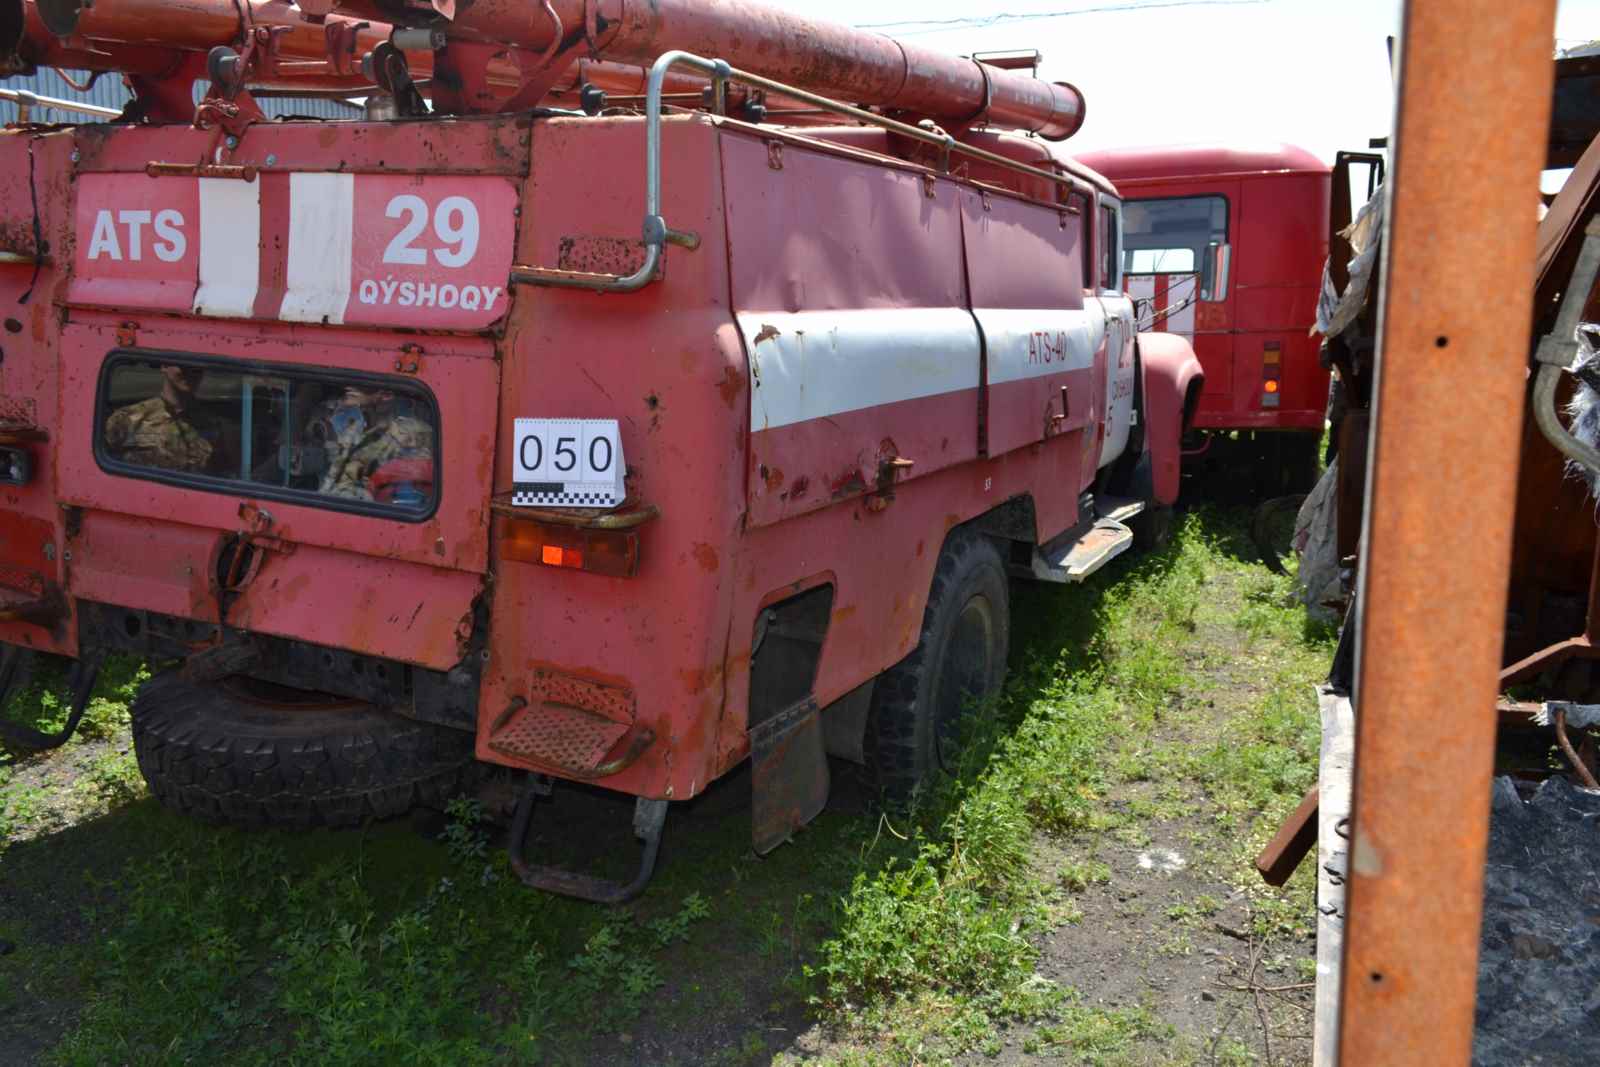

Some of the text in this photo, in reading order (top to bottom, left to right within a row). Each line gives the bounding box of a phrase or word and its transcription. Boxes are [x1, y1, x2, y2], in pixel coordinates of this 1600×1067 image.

[87, 208, 187, 263] ATS
[382, 194, 480, 268] 29
[359, 275, 502, 311] QÝSHOQY
[519, 434, 613, 472] 050
